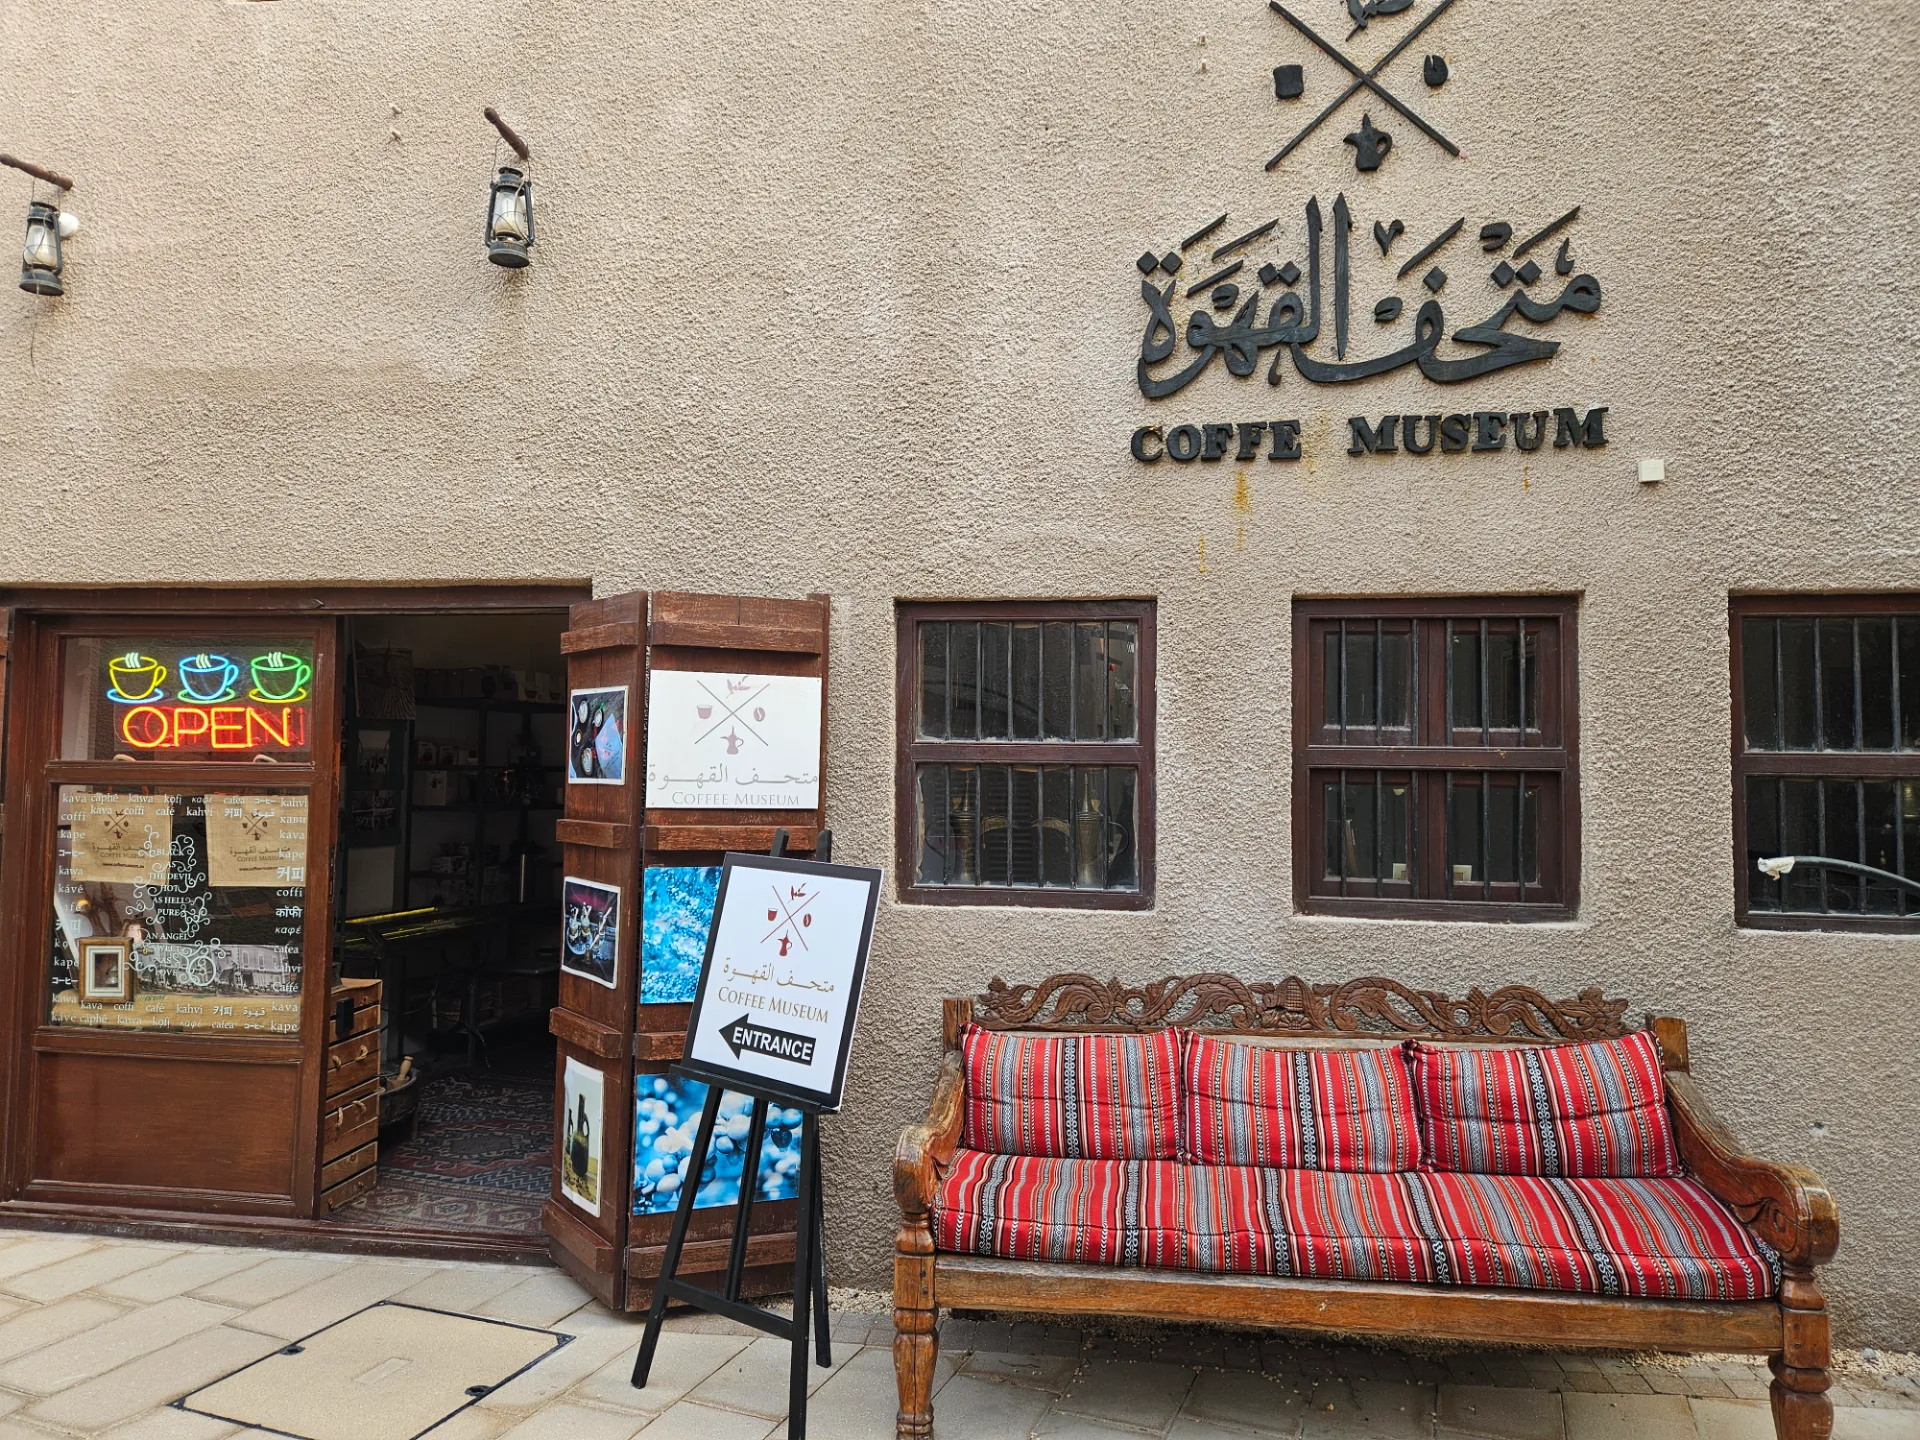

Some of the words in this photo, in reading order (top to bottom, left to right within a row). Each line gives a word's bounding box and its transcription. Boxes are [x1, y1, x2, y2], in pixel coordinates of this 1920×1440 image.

[1131, 419, 1301, 462] COFFE
[1347, 406, 1610, 456] MUSEUM
[122, 705, 291, 749] OPEN
[648, 763, 729, 790] القهوة
[735, 767, 818, 786] متحف
[156, 806, 176, 816] café
[186, 807, 213, 816] kahvi
[224, 808, 243, 818] 커피
[60, 829, 86, 842] kape
[280, 829, 306, 840] kava
[156, 848, 185, 856] BLACK
[278, 848, 304, 861] kape
[58, 866, 84, 875] kawa
[149, 872, 166, 880] THE
[277, 866, 305, 882] 커피
[58, 883, 84, 894] kávé
[276, 887, 303, 897] coffi
[275, 905, 303, 919] कॉफी
[146, 932, 158, 940] AN
[160, 932, 190, 940] ANGEL
[274, 926, 302, 936] καφέ
[274, 943, 299, 954] cafea
[723, 957, 775, 985] القهوة
[776, 970, 834, 992] متحف
[52, 993, 77, 1003] kawa
[80, 1000, 103, 1010] kava
[114, 1001, 134, 1011] coffi
[145, 1003, 165, 1012] café
[176, 1004, 204, 1014] kahvi
[213, 1006, 233, 1016] 커피
[242, 1007, 266, 1018] قهوة
[271, 1002, 298, 1012] kava
[270, 1020, 298, 1034] kape
[732, 1026, 813, 1061] ENTRANCE
